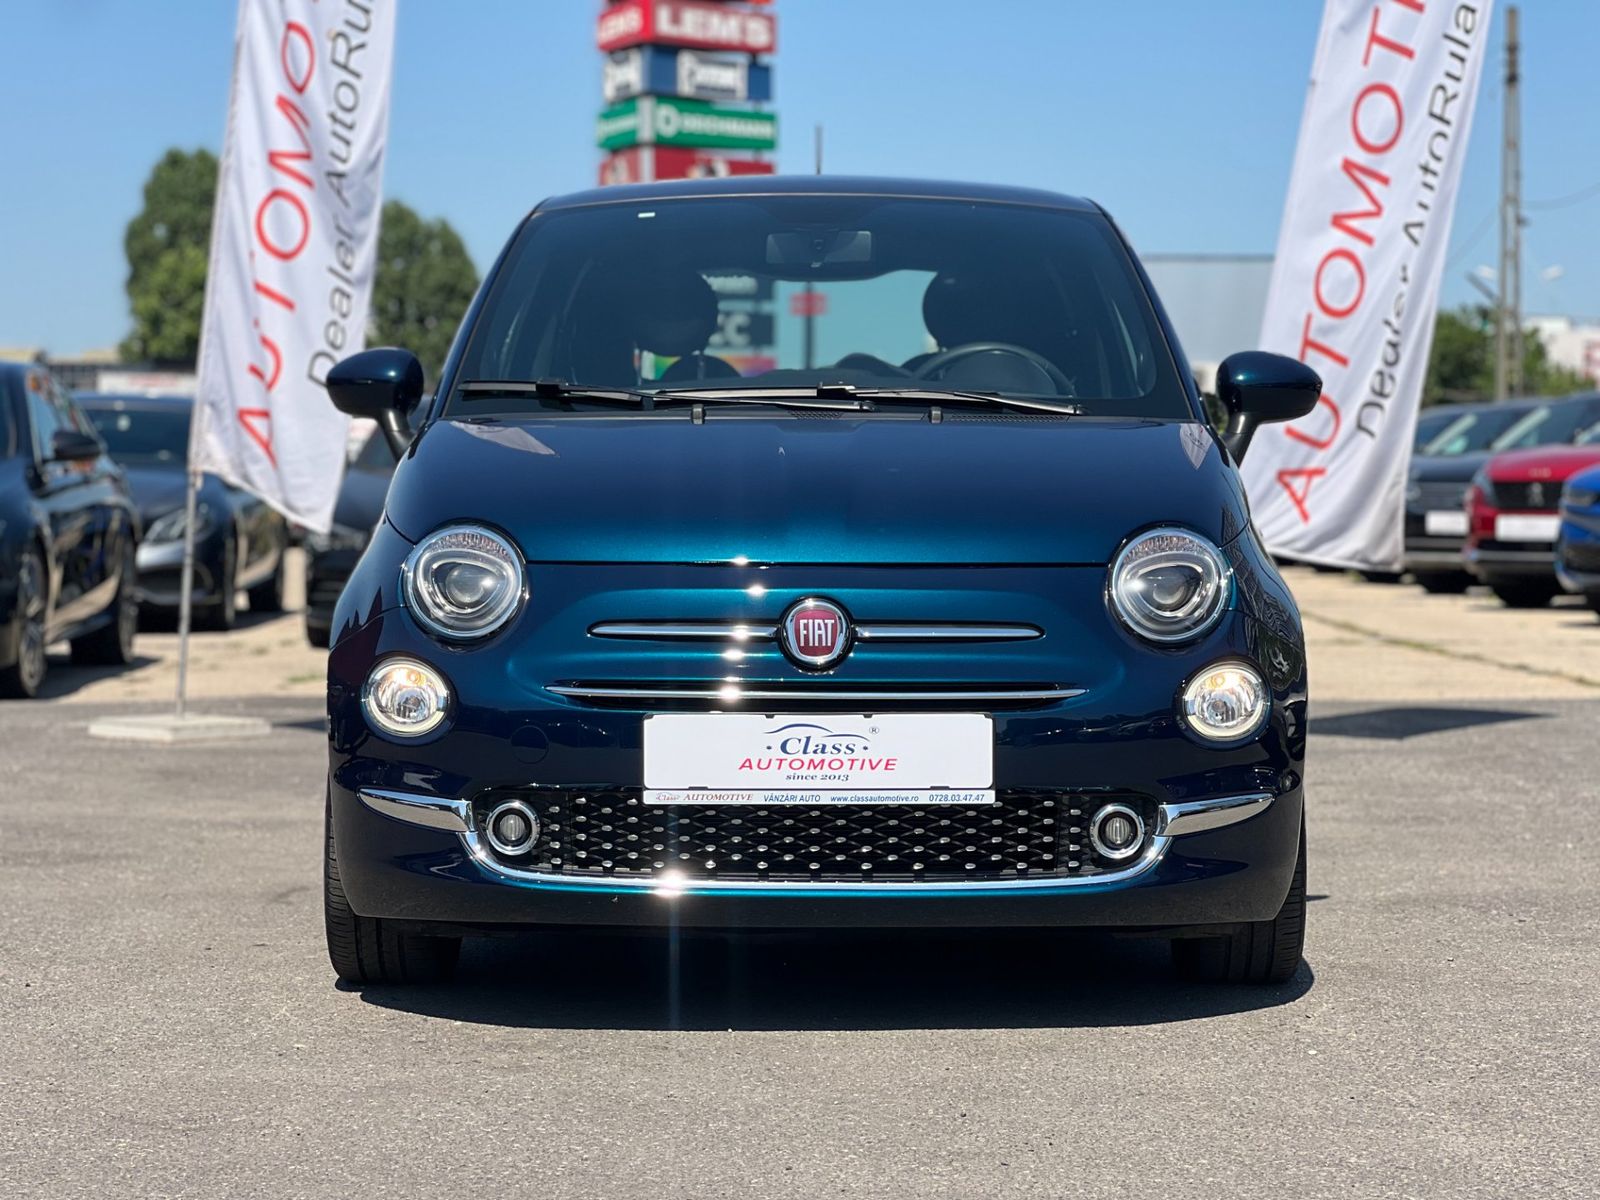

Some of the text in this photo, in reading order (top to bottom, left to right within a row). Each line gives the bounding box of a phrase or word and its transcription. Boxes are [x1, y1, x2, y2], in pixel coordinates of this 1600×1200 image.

[307, 0, 373, 388] Dealer AutoRu
[799, 619, 835, 647] FIAT
[780, 736, 856, 755] Class
[738, 758, 898, 771] AUTOMOTIVE
[785, 772, 850, 782] since 2013
[683, 793, 753, 801] AUTOMOTIVE
[799, 794, 821, 802] AUTO
[830, 794, 920, 802] www.classautomotive.ro
[929, 794, 985, 802] 0728.03.47.47
